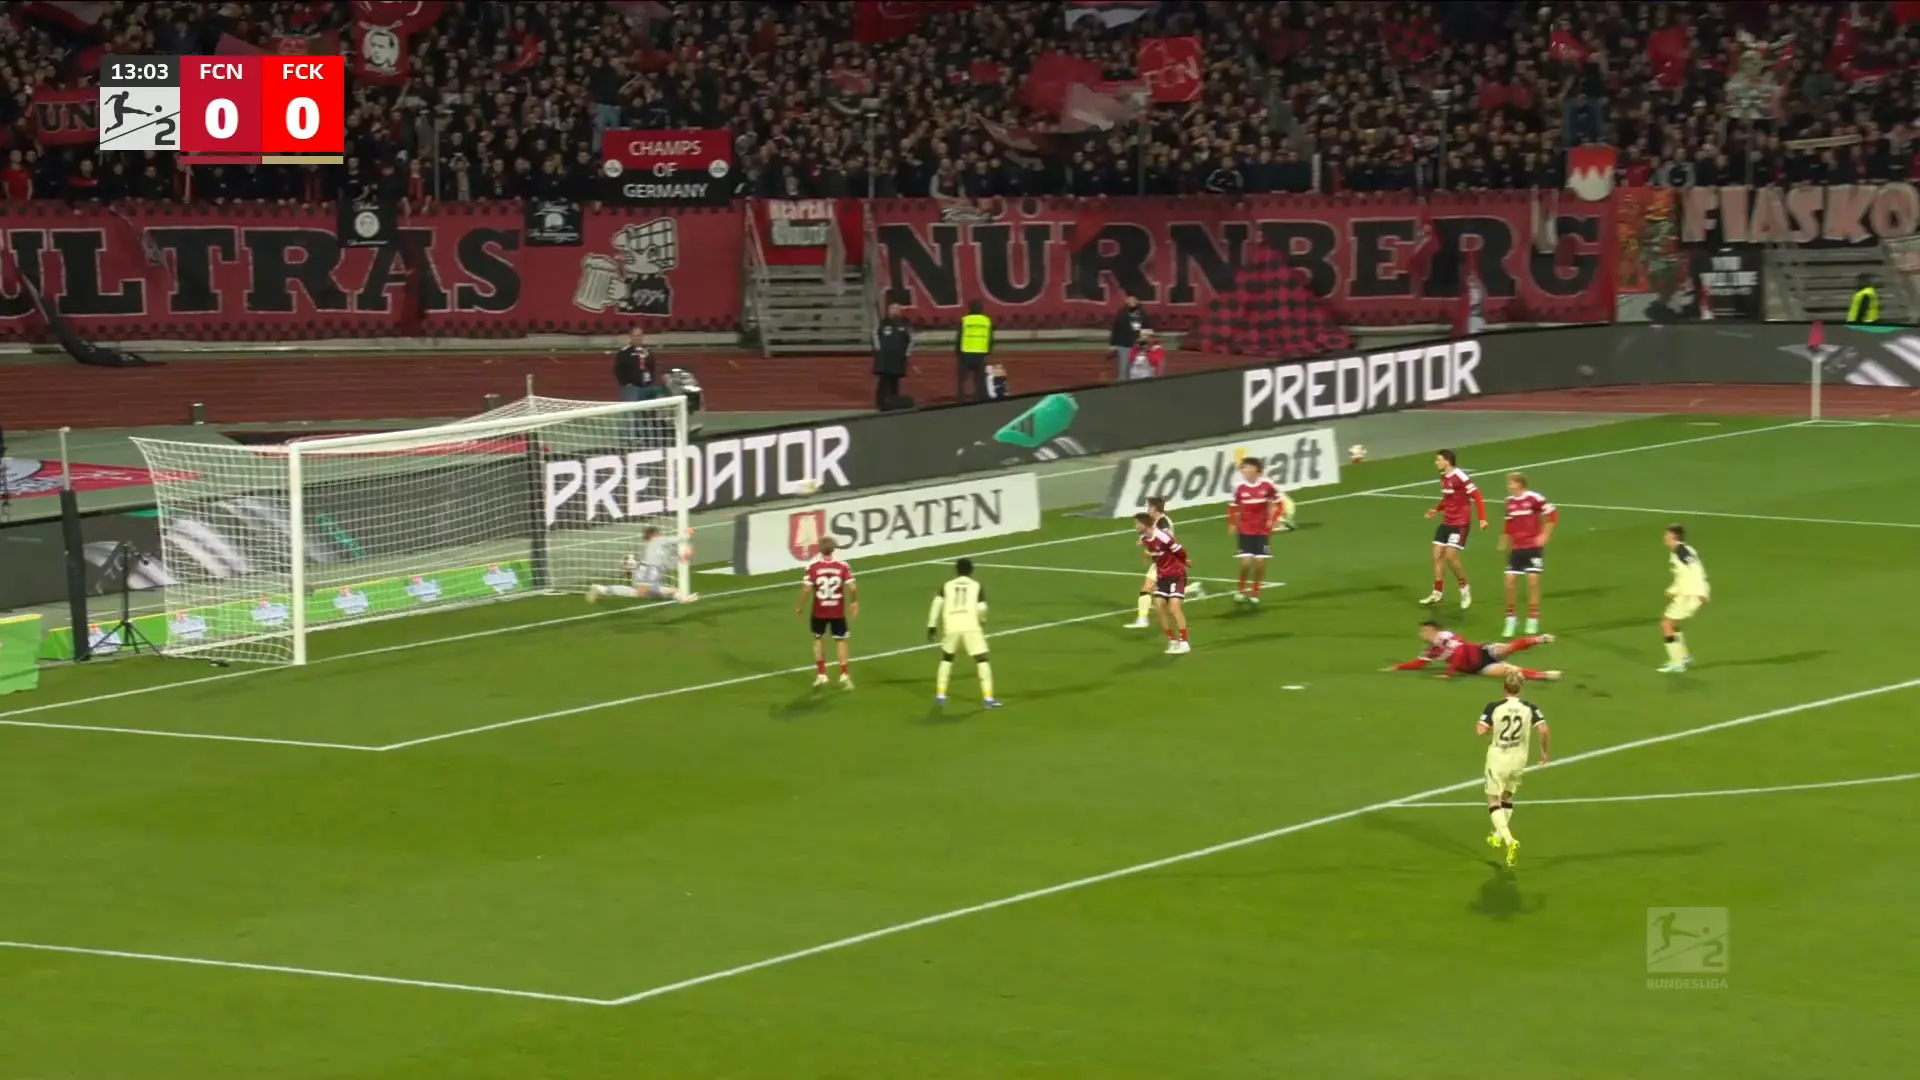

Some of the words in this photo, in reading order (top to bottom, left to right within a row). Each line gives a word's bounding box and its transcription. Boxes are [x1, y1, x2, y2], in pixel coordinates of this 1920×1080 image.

[628, 140, 703, 156] CHAMPS
[652, 162, 678, 178] OF
[622, 183, 709, 199] GERMANY
[1681, 181, 1920, 244] FIASKO
[877, 197, 1600, 309] NÜRNBERG
[1243, 340, 1481, 426] PREDATOR
[544, 424, 851, 526] PREDATOR
[1136, 437, 1322, 508] toolcaft
[830, 488, 1004, 551] SPATEN
[815, 576, 843, 600] 32
[954, 586, 968, 609] 11
[1499, 715, 1523, 742] 22
